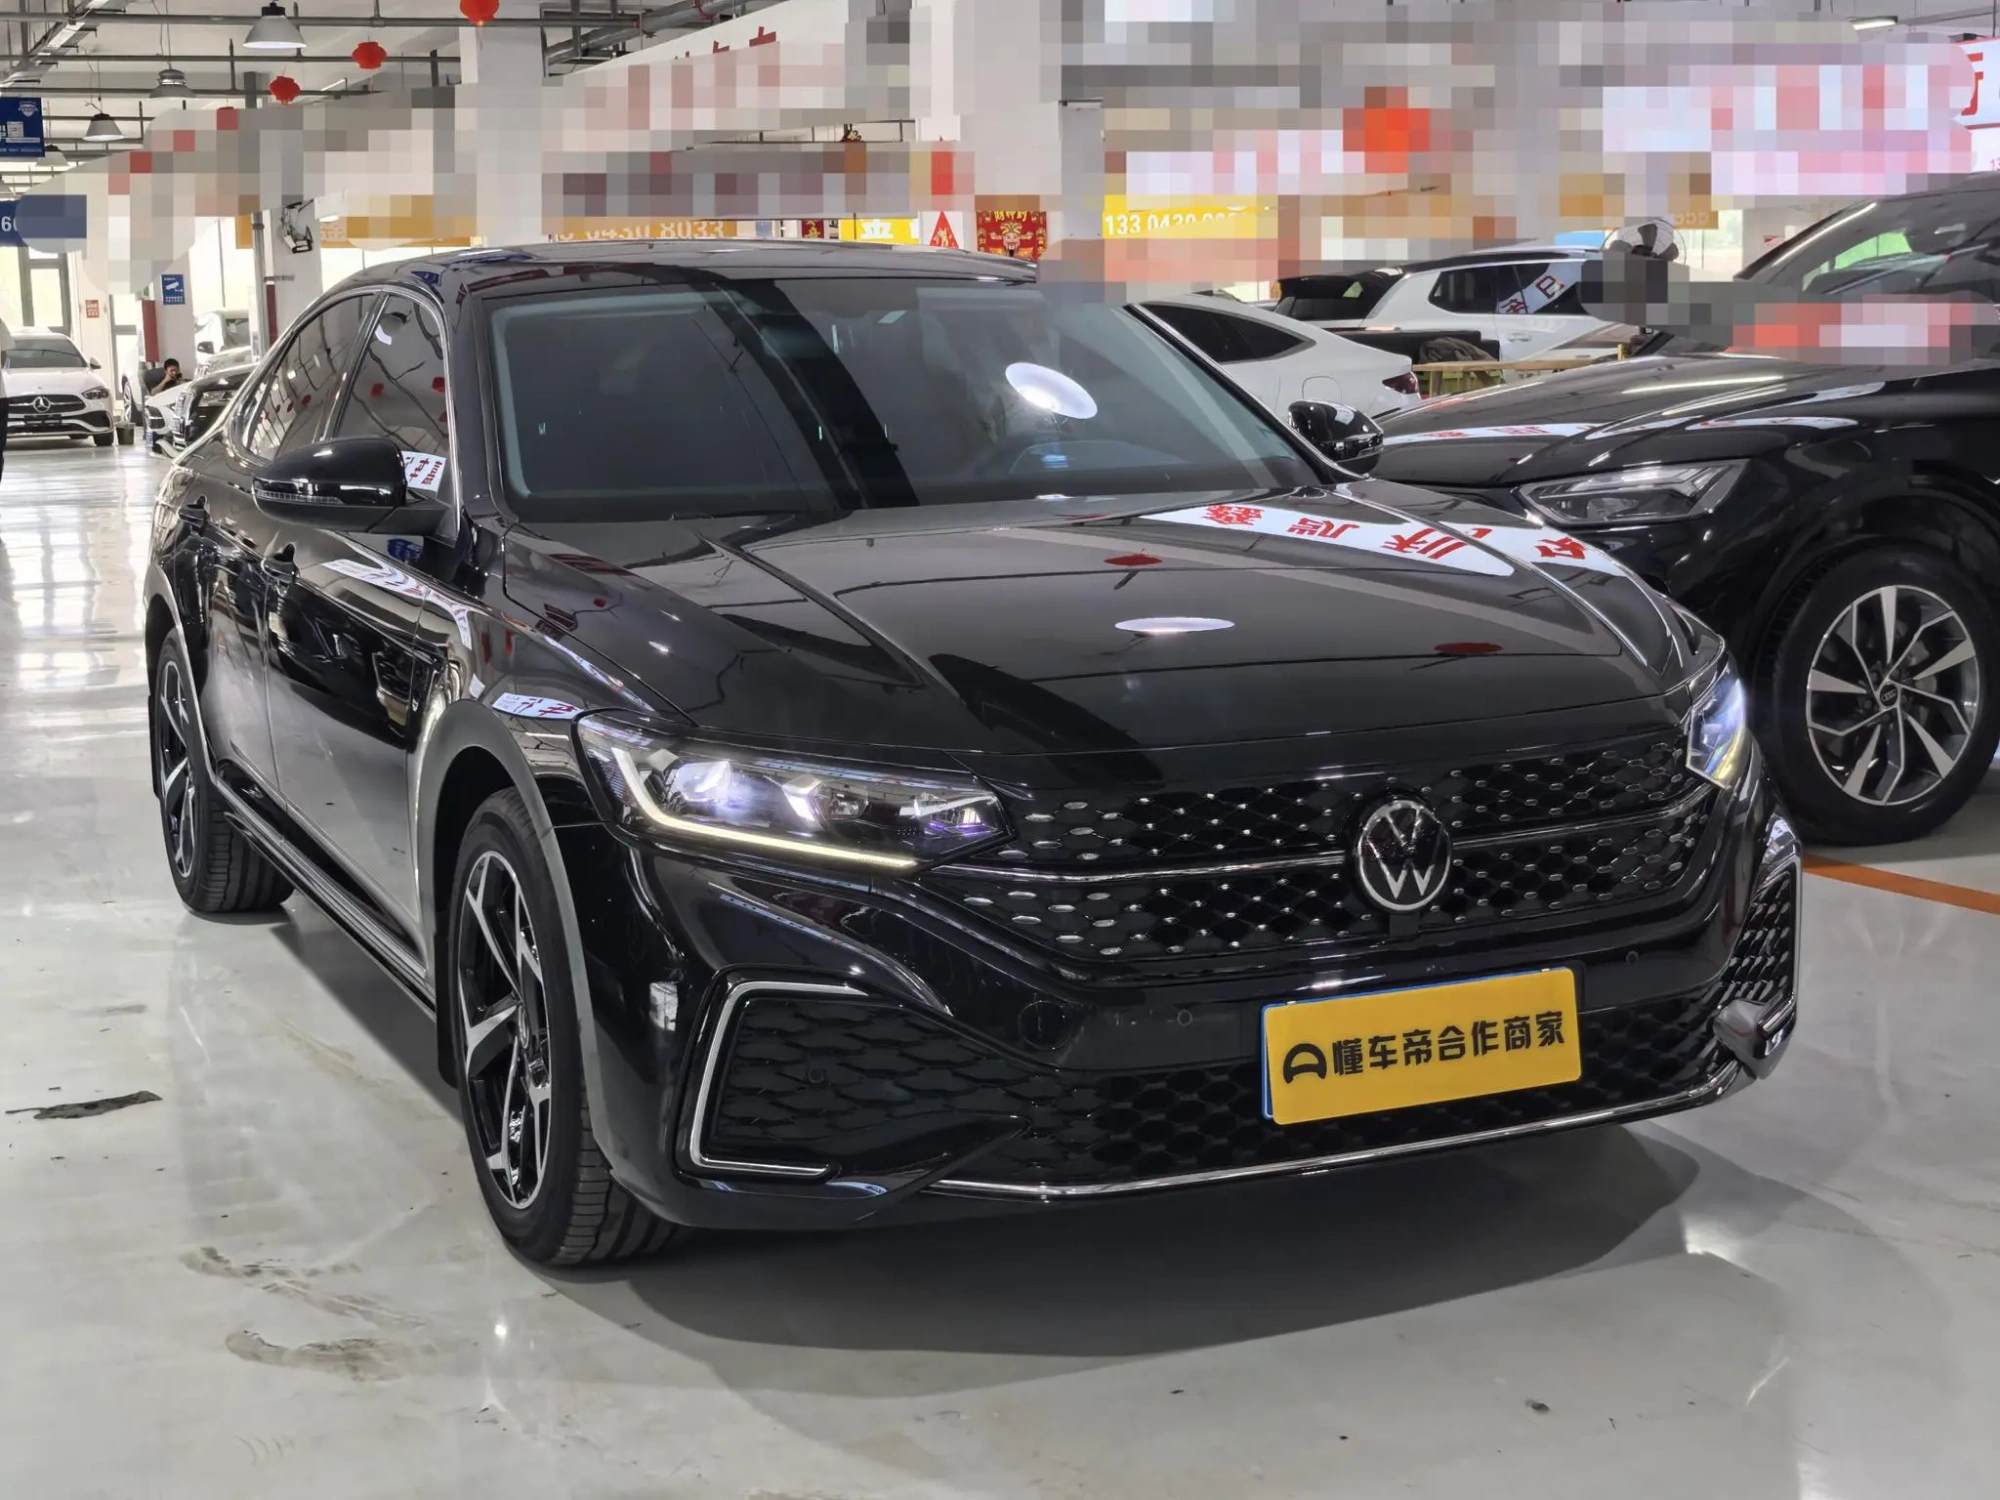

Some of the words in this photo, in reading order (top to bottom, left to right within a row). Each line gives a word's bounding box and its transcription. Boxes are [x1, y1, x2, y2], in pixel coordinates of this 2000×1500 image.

[1, 215, 17, 232] 6
[1105, 214, 1141, 236] 133
[1332, 1010, 1565, 1077] 懂车帝合作商家
